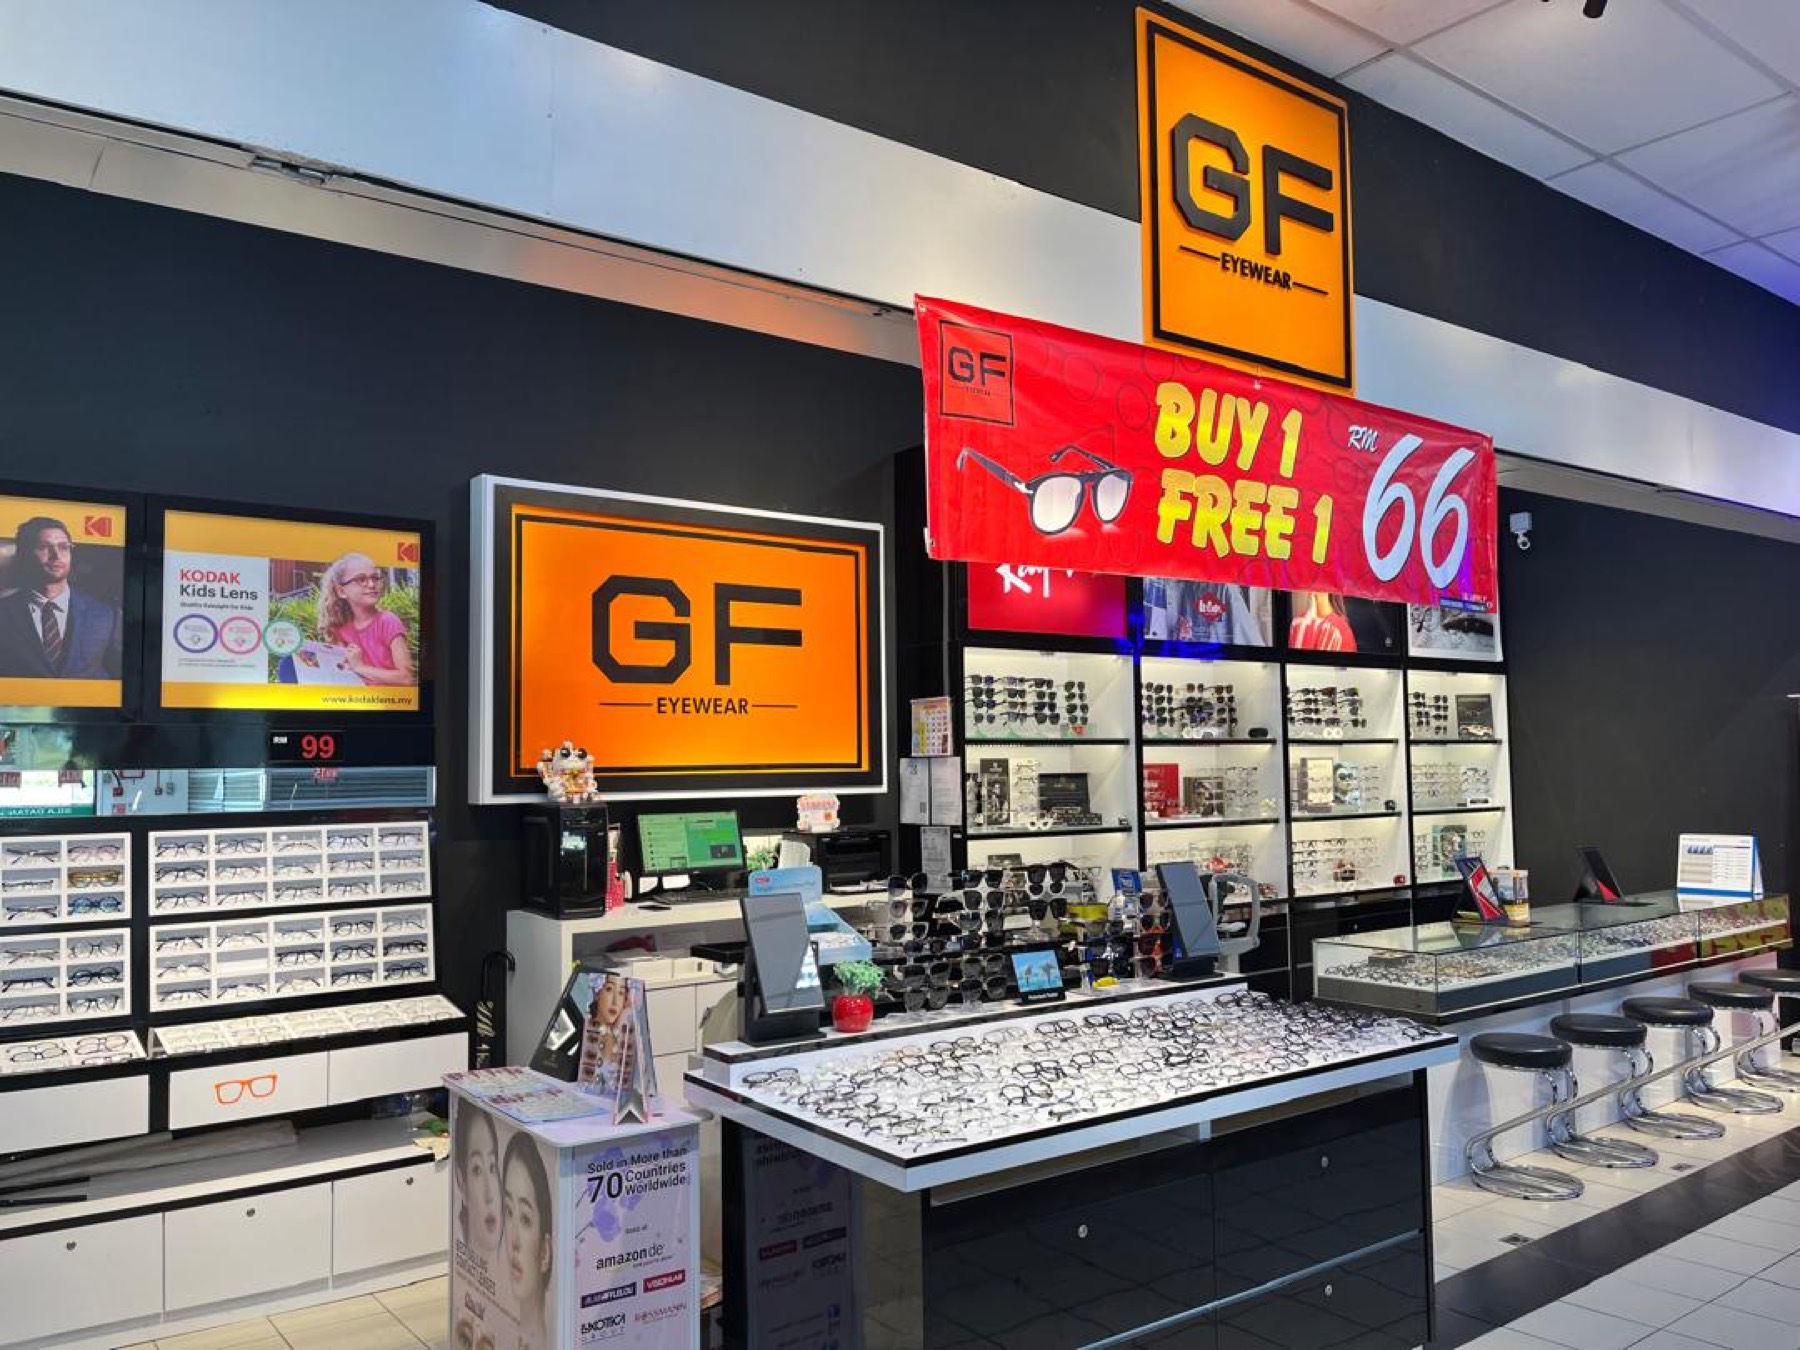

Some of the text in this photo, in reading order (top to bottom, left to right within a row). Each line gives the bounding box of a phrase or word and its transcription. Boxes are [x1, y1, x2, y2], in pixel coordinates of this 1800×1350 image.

[1171, 112, 1334, 256] GF
[1220, 252, 1293, 292] EYEWEAR
[948, 346, 1007, 386] GF
[1154, 381, 1302, 479] BUY 1
[1347, 424, 1379, 454] RM
[1156, 468, 1333, 564] FREE 1
[1362, 433, 1476, 589] 66
[180, 569, 241, 584] KODAK
[180, 584, 259, 600] Kids Lens
[592, 575, 802, 686] GF
[656, 697, 749, 714] EYEWEAR
[301, 734, 335, 759] 99
[587, 1146, 687, 1174] Sold in More than
[587, 1161, 686, 1203] 70 Countries
[625, 1174, 687, 1195] Worldwide
